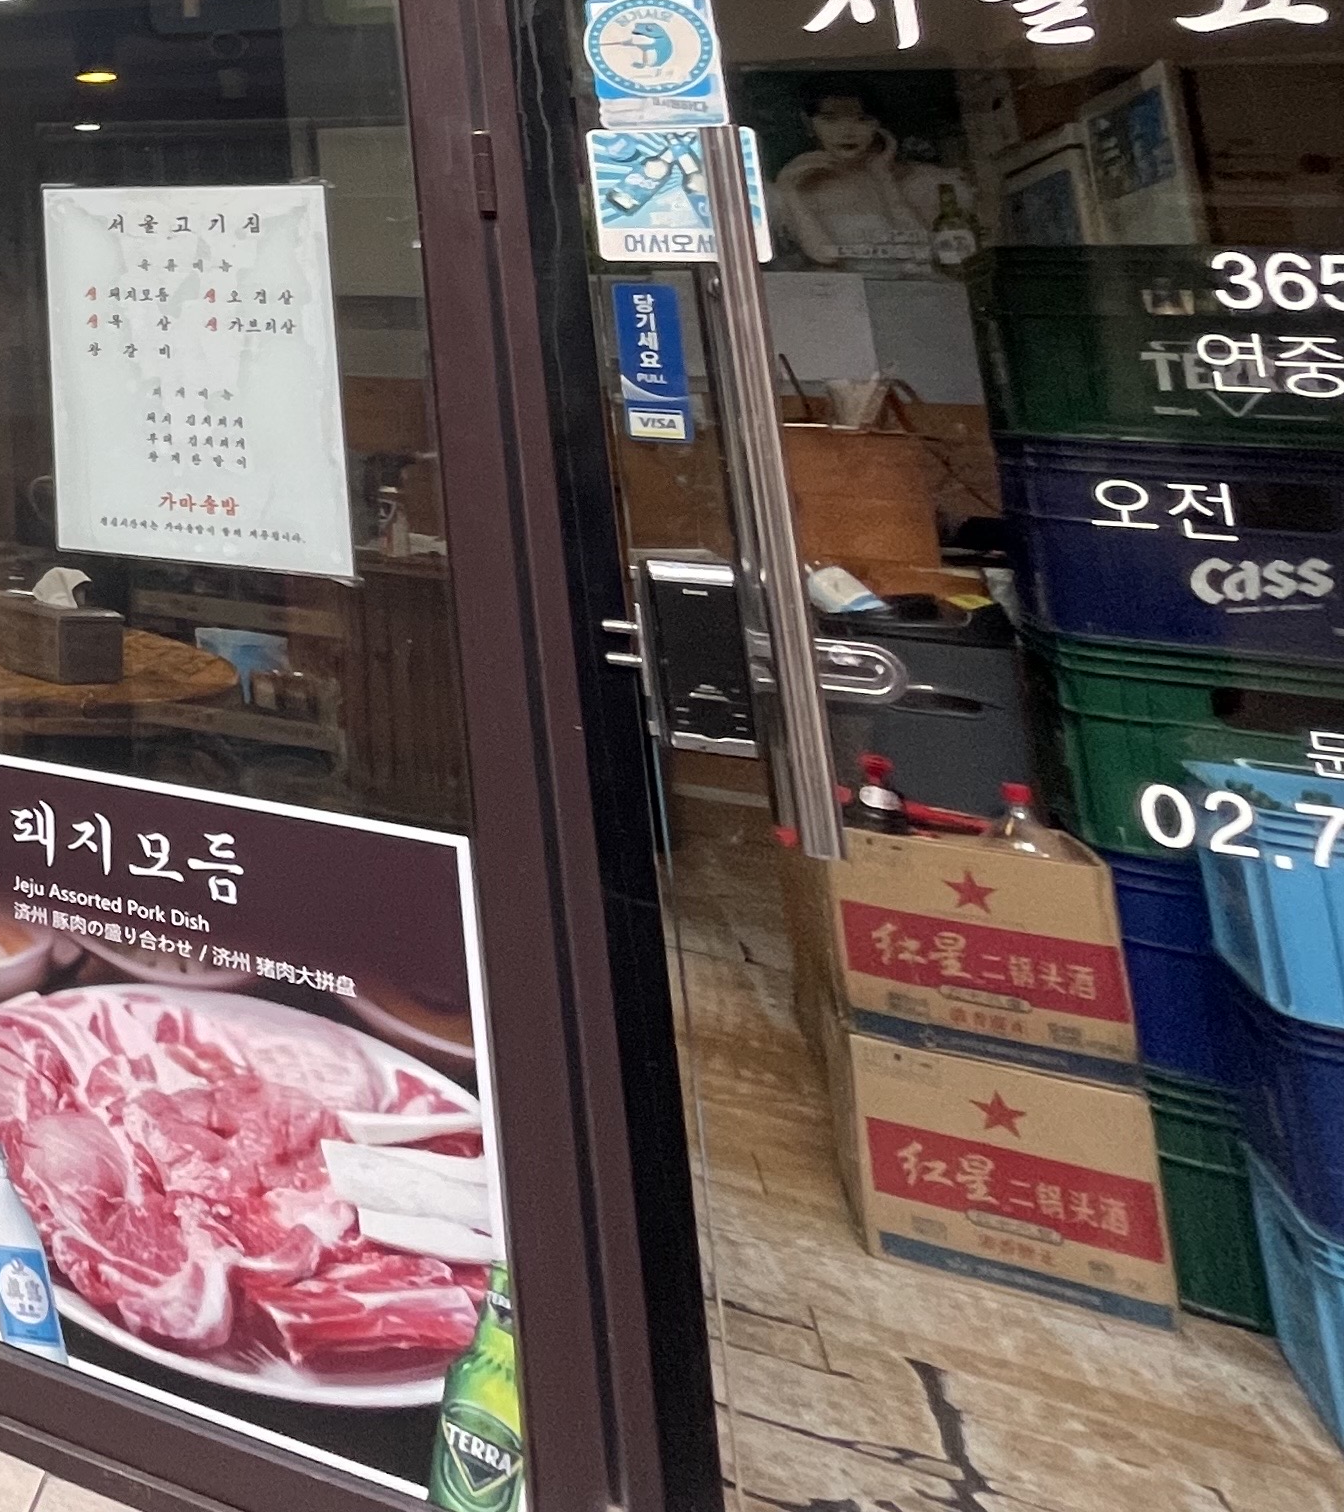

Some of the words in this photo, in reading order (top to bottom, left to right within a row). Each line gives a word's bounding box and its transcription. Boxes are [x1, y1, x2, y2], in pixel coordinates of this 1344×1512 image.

[108, 213, 261, 234] 서울고기집
[624, 233, 717, 254] 어서오세
[227, 317, 296, 334] 가브리살
[632, 293, 662, 369] 당기세요
[636, 372, 668, 386] PULL
[1196, 332, 1344, 400] 연중
[639, 415, 678, 430] VISA
[158, 491, 240, 516] 가마솥밥
[1091, 479, 1240, 543] 오전
[1189, 557, 1335, 606] Cass
[9, 799, 245, 906] 돼지모듬
[13, 875, 45, 898] Jeju
[48, 882, 123, 915] Assorted
[126, 898, 166, 924] Pork
[170, 908, 211, 934] Dish
[446, 1421, 512, 1478] TERRA
